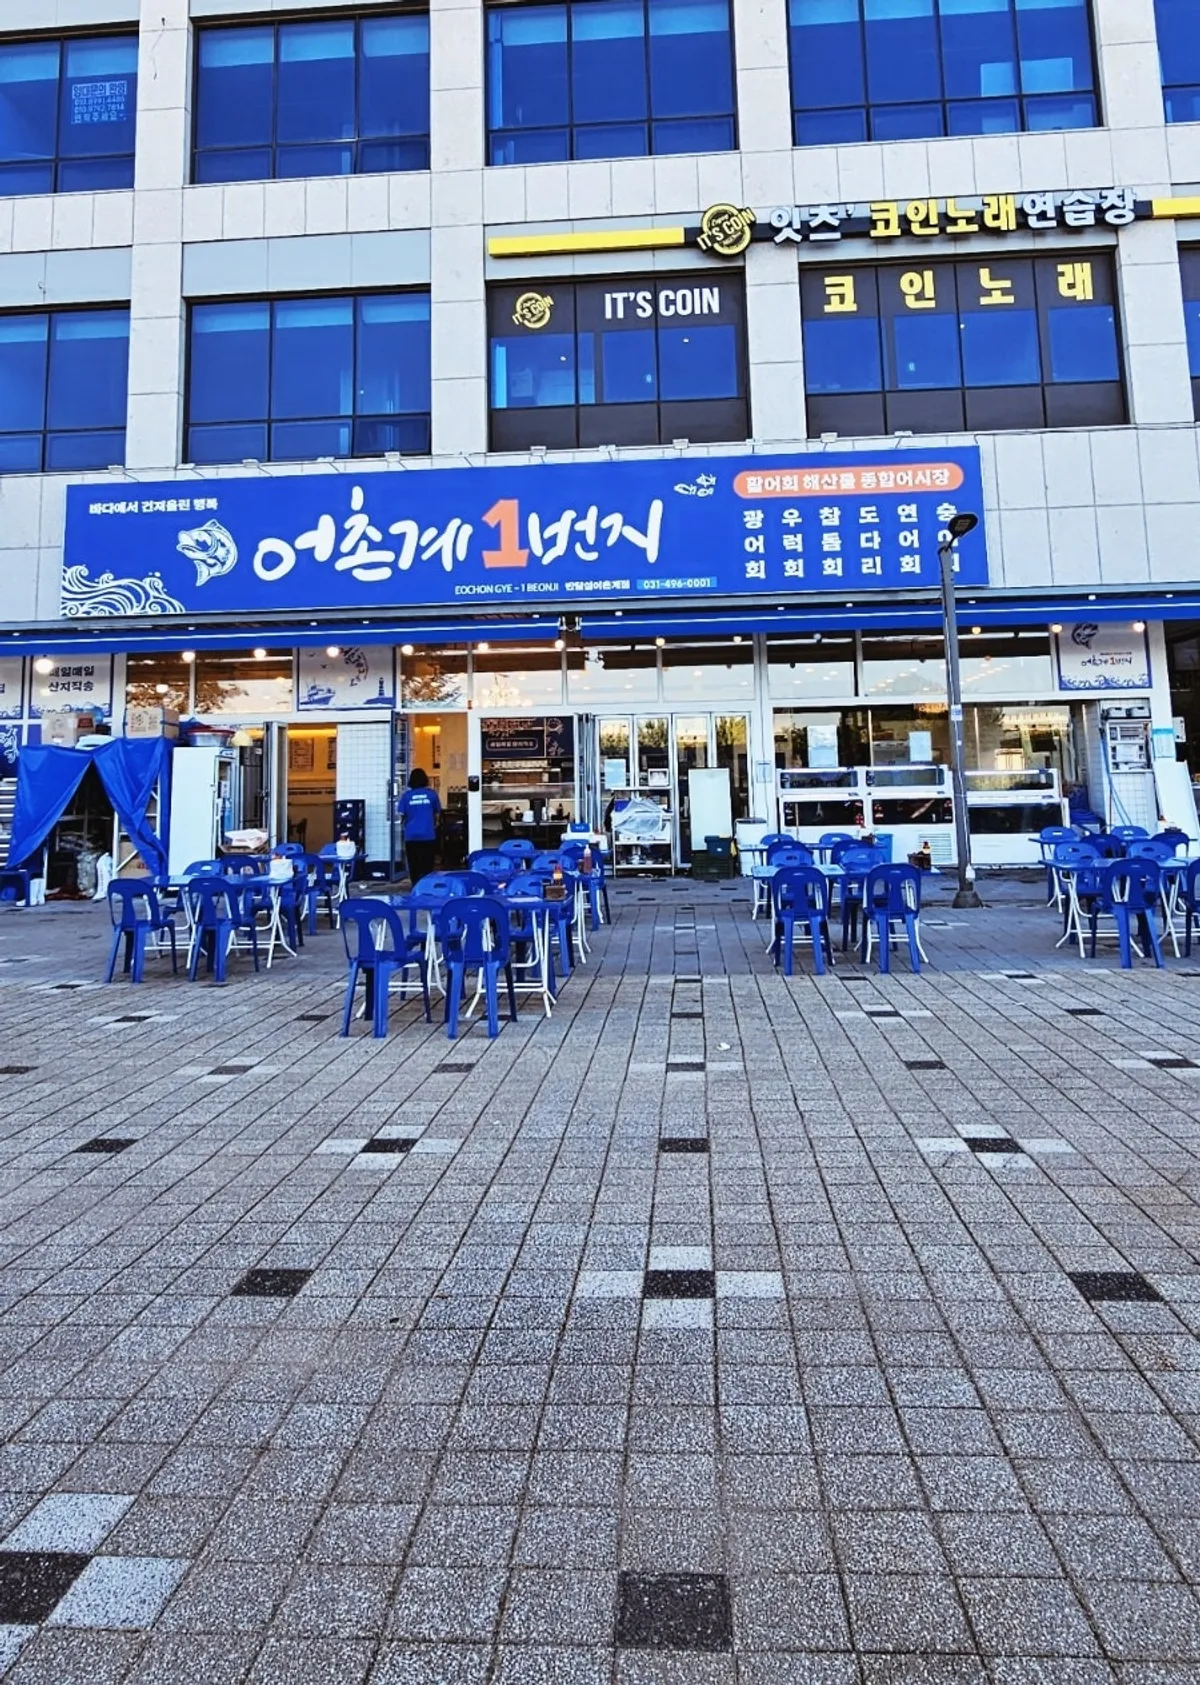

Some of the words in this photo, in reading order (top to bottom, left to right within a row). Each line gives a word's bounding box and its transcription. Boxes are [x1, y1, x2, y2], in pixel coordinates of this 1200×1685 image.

[696, 227, 725, 250] IT'S
[722, 208, 756, 235] COIN
[604, 291, 653, 319] IT'S
[658, 286, 720, 317] COIN
[802, 472, 856, 491] 해산물
[860, 468, 951, 489] 종합어시장
[89, 500, 139, 515] 바다에서
[193, 497, 218, 511] 행복
[742, 509, 766, 579] 광어회
[781, 508, 804, 577] 우럭회
[858, 505, 882, 575] 도다리
[897, 503, 921, 574] 연어회
[454, 584, 494, 595] EOCHON
[494, 583, 513, 594] GYE
[643, 578, 711, 589] 031-496-0001
[48, 680, 94, 692] 산지직송
